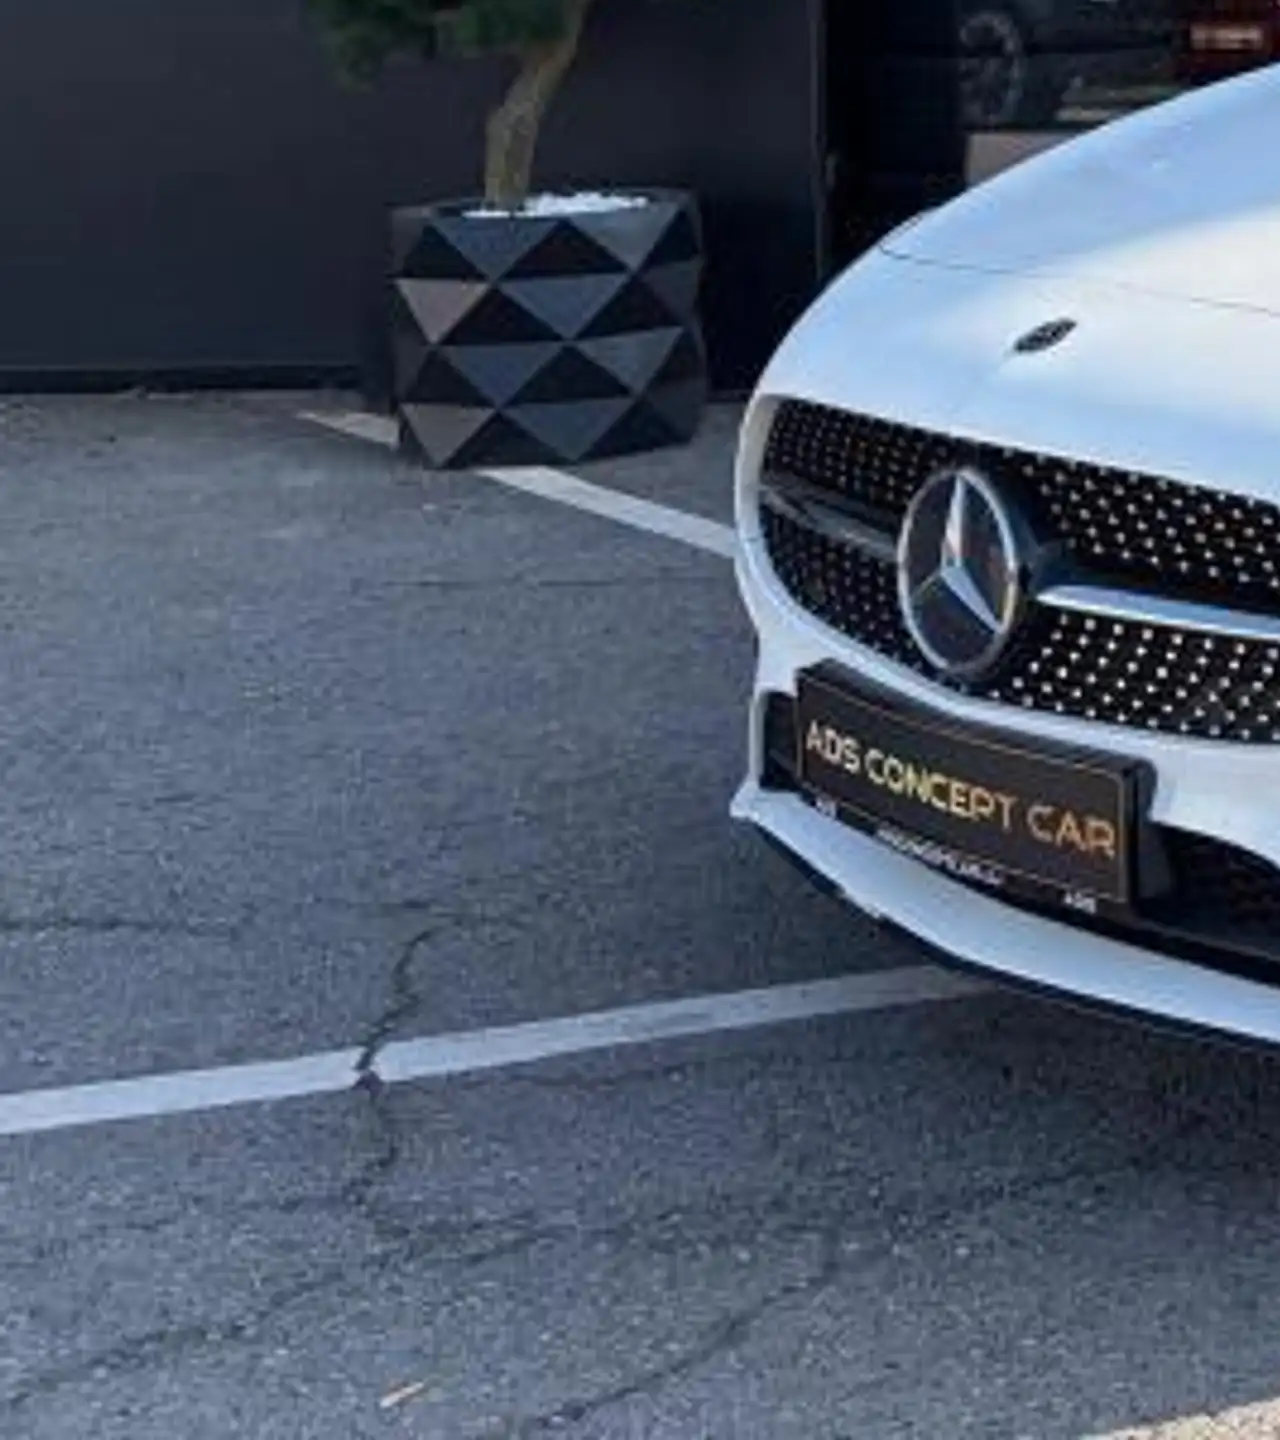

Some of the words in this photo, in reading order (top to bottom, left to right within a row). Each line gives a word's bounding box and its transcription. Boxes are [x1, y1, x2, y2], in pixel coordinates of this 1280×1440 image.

[805, 719, 861, 774] ADS
[864, 748, 1018, 829] CONCEPT
[1026, 804, 1115, 860] CAR
